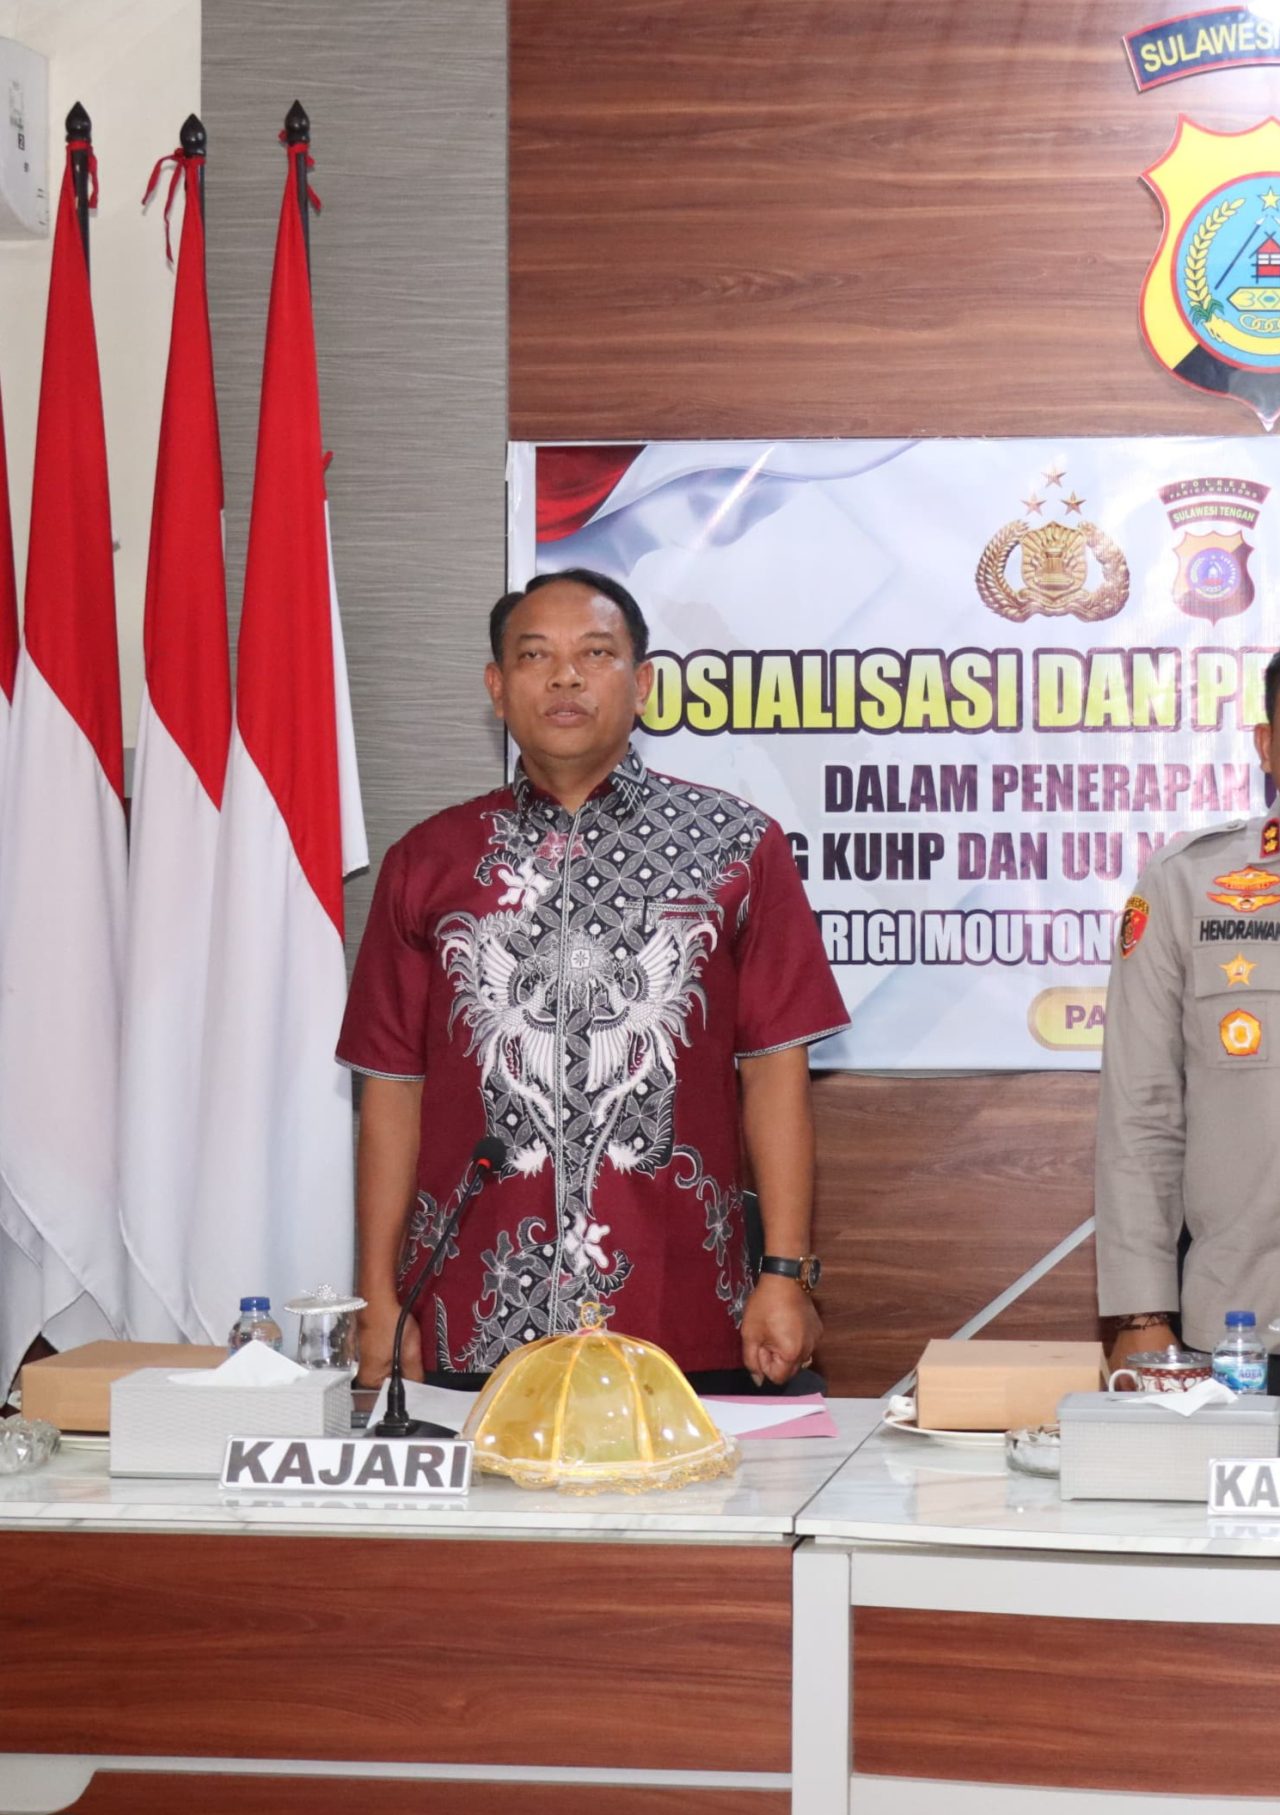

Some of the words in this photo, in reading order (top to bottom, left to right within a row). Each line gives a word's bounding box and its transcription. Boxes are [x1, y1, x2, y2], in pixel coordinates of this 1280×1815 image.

[1140, 22, 1280, 73] SULAWESI
[1180, 479, 1247, 489] POLRES
[1173, 506, 1218, 523] SULAWESI
[1220, 506, 1255, 522] TENGAH
[638, 648, 1022, 735] OSIALISASI
[1034, 647, 1181, 734] DAN
[824, 763, 978, 814] DALAM
[992, 762, 1251, 813] PENERAPAN
[822, 831, 945, 881] KUHP
[958, 831, 1048, 881] DAN
[1062, 831, 1123, 881] UU
[816, 909, 916, 966] RIGI
[922, 908, 1122, 966] MOUTON
[227, 1440, 468, 1488] KAJARI
